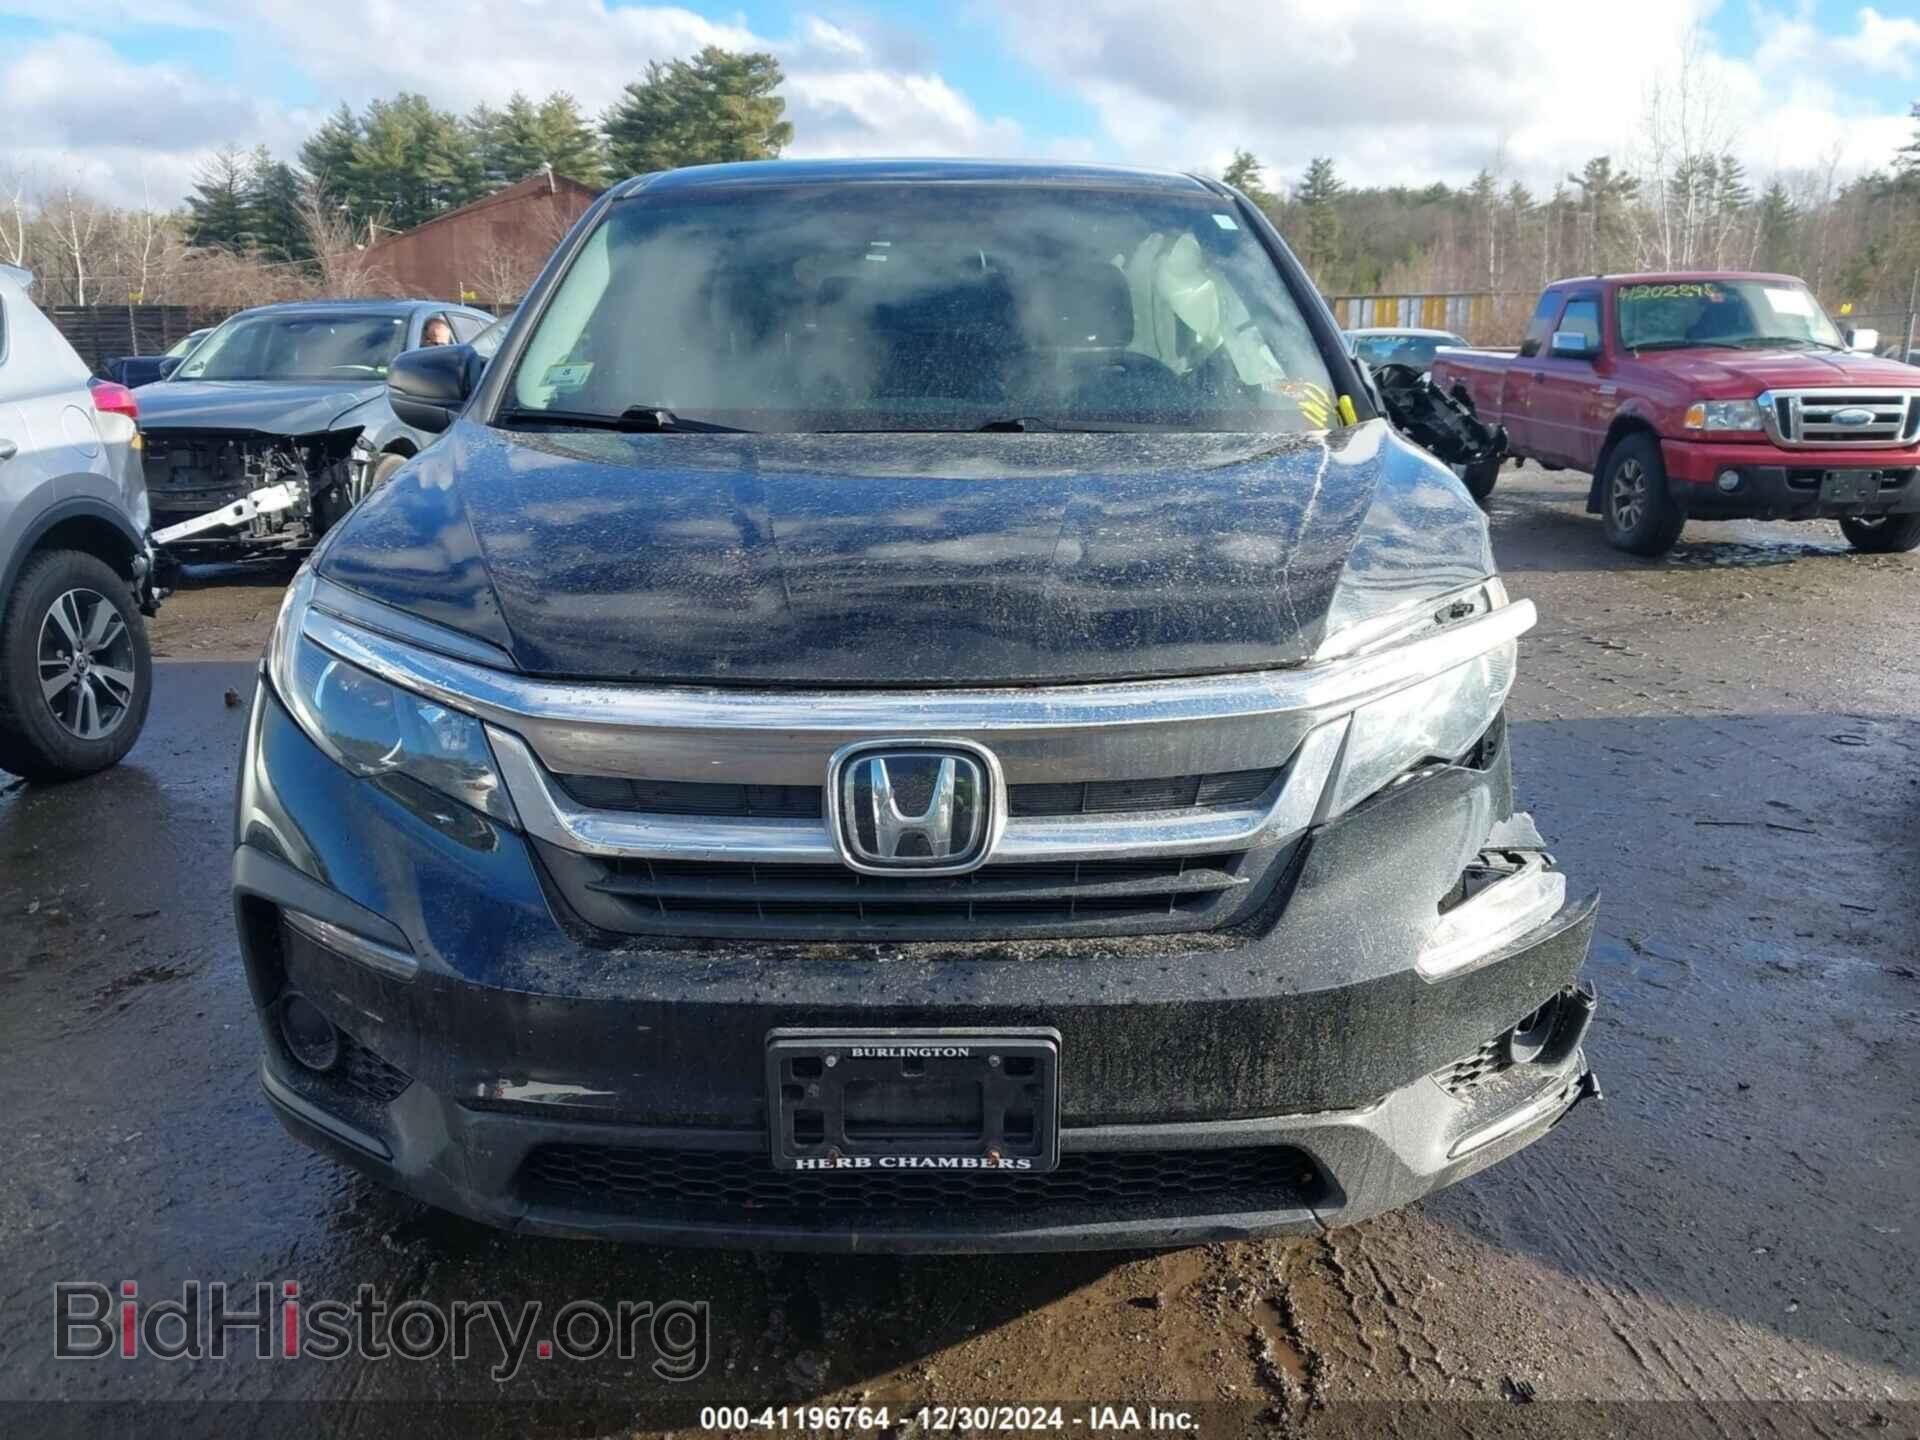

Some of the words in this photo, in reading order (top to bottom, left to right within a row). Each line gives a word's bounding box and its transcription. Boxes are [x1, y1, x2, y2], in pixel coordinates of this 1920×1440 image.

[852, 1047, 969, 1057] BURLINGTON
[795, 1157, 872, 1169] HERB
[879, 1156, 1031, 1169] CHAMBERS
